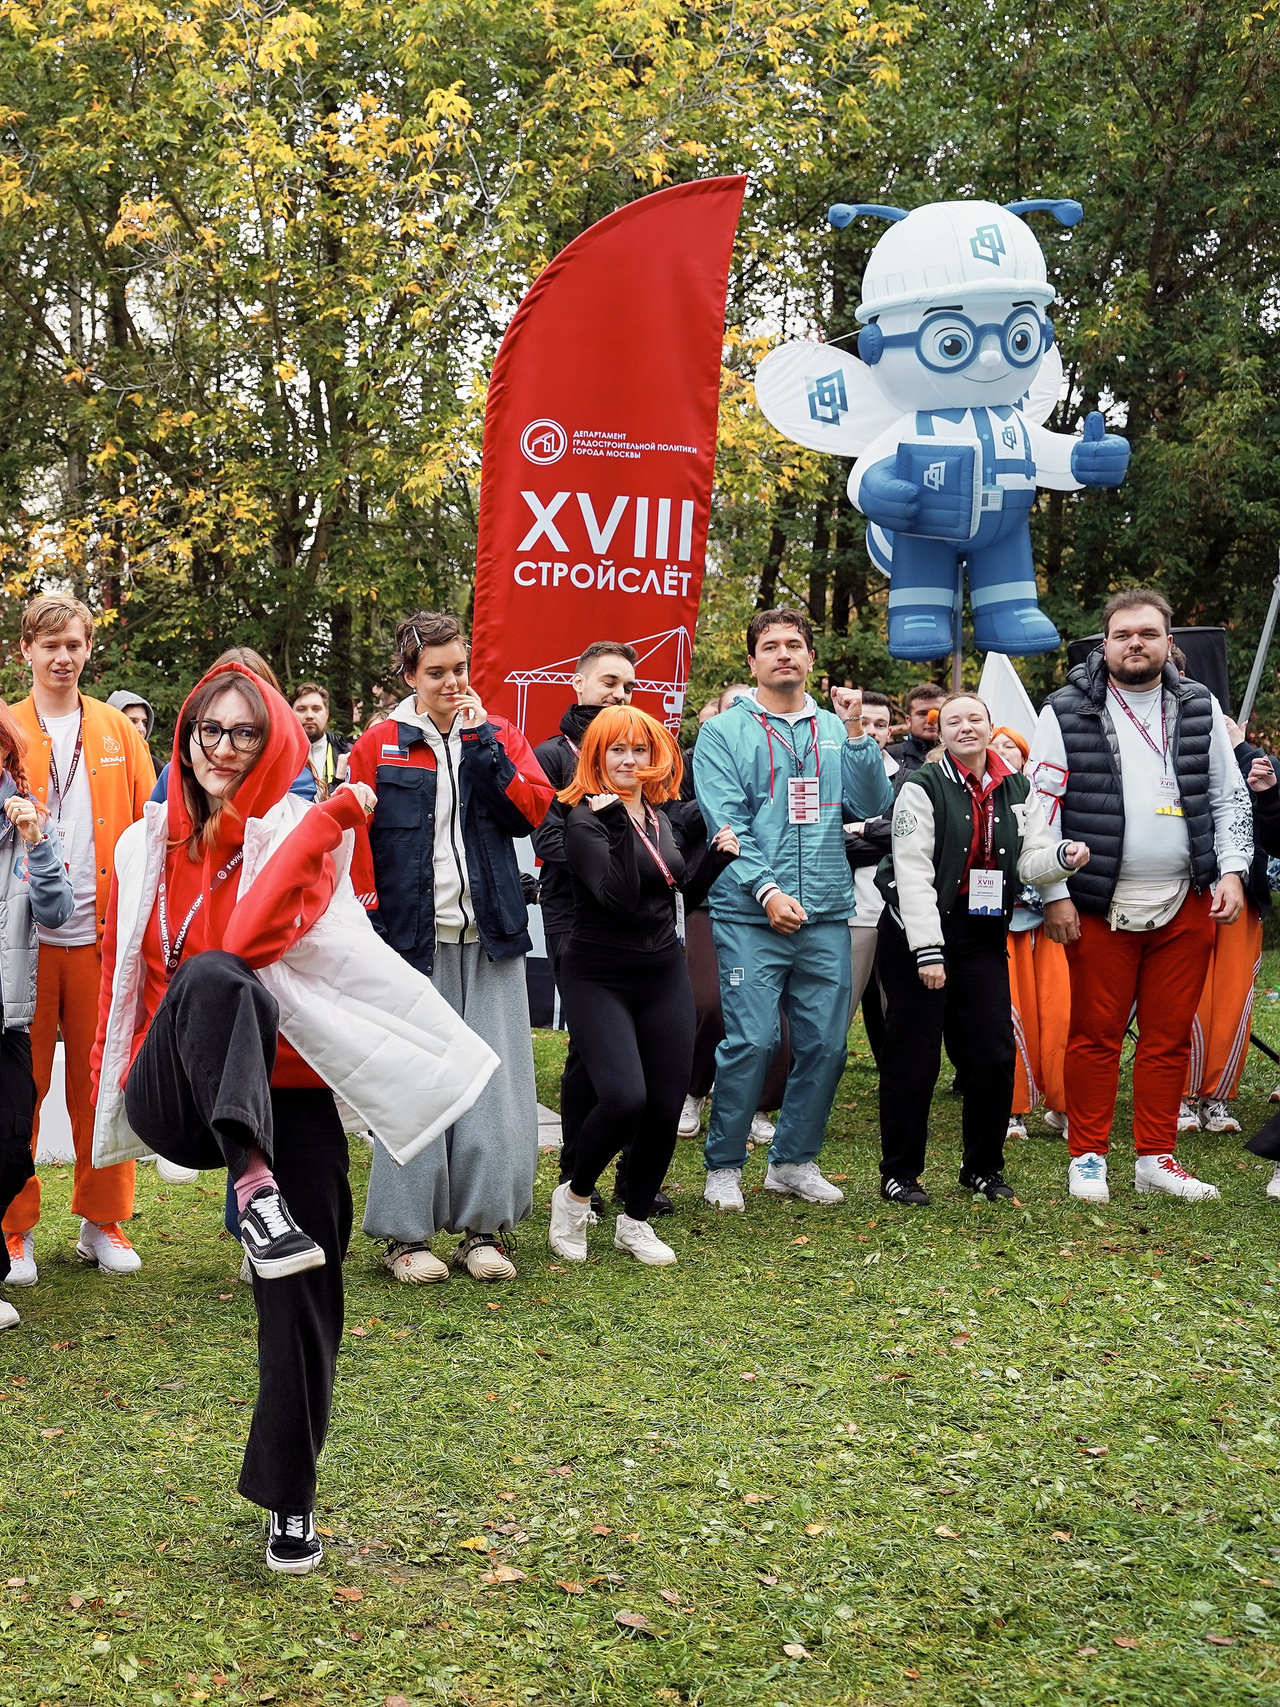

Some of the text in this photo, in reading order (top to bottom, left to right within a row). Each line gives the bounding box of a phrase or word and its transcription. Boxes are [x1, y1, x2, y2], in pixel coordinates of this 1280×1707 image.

[572, 439, 697, 454] ГРАДОСТРОИТЕЛЬНОЙ ПОЛИТИКИ
[572, 448, 641, 459] ГОРОДА МОСКВЫ
[573, 430, 626, 440] ДЕПАРТАМЕНТ
[516, 490, 694, 562] XVIII
[513, 559, 692, 597] СТРОЙСЛЁТ
[160, 902, 169, 940] ФУНДАМЕНТ
[174, 910, 195, 950] ФУНДАМЕНТ
